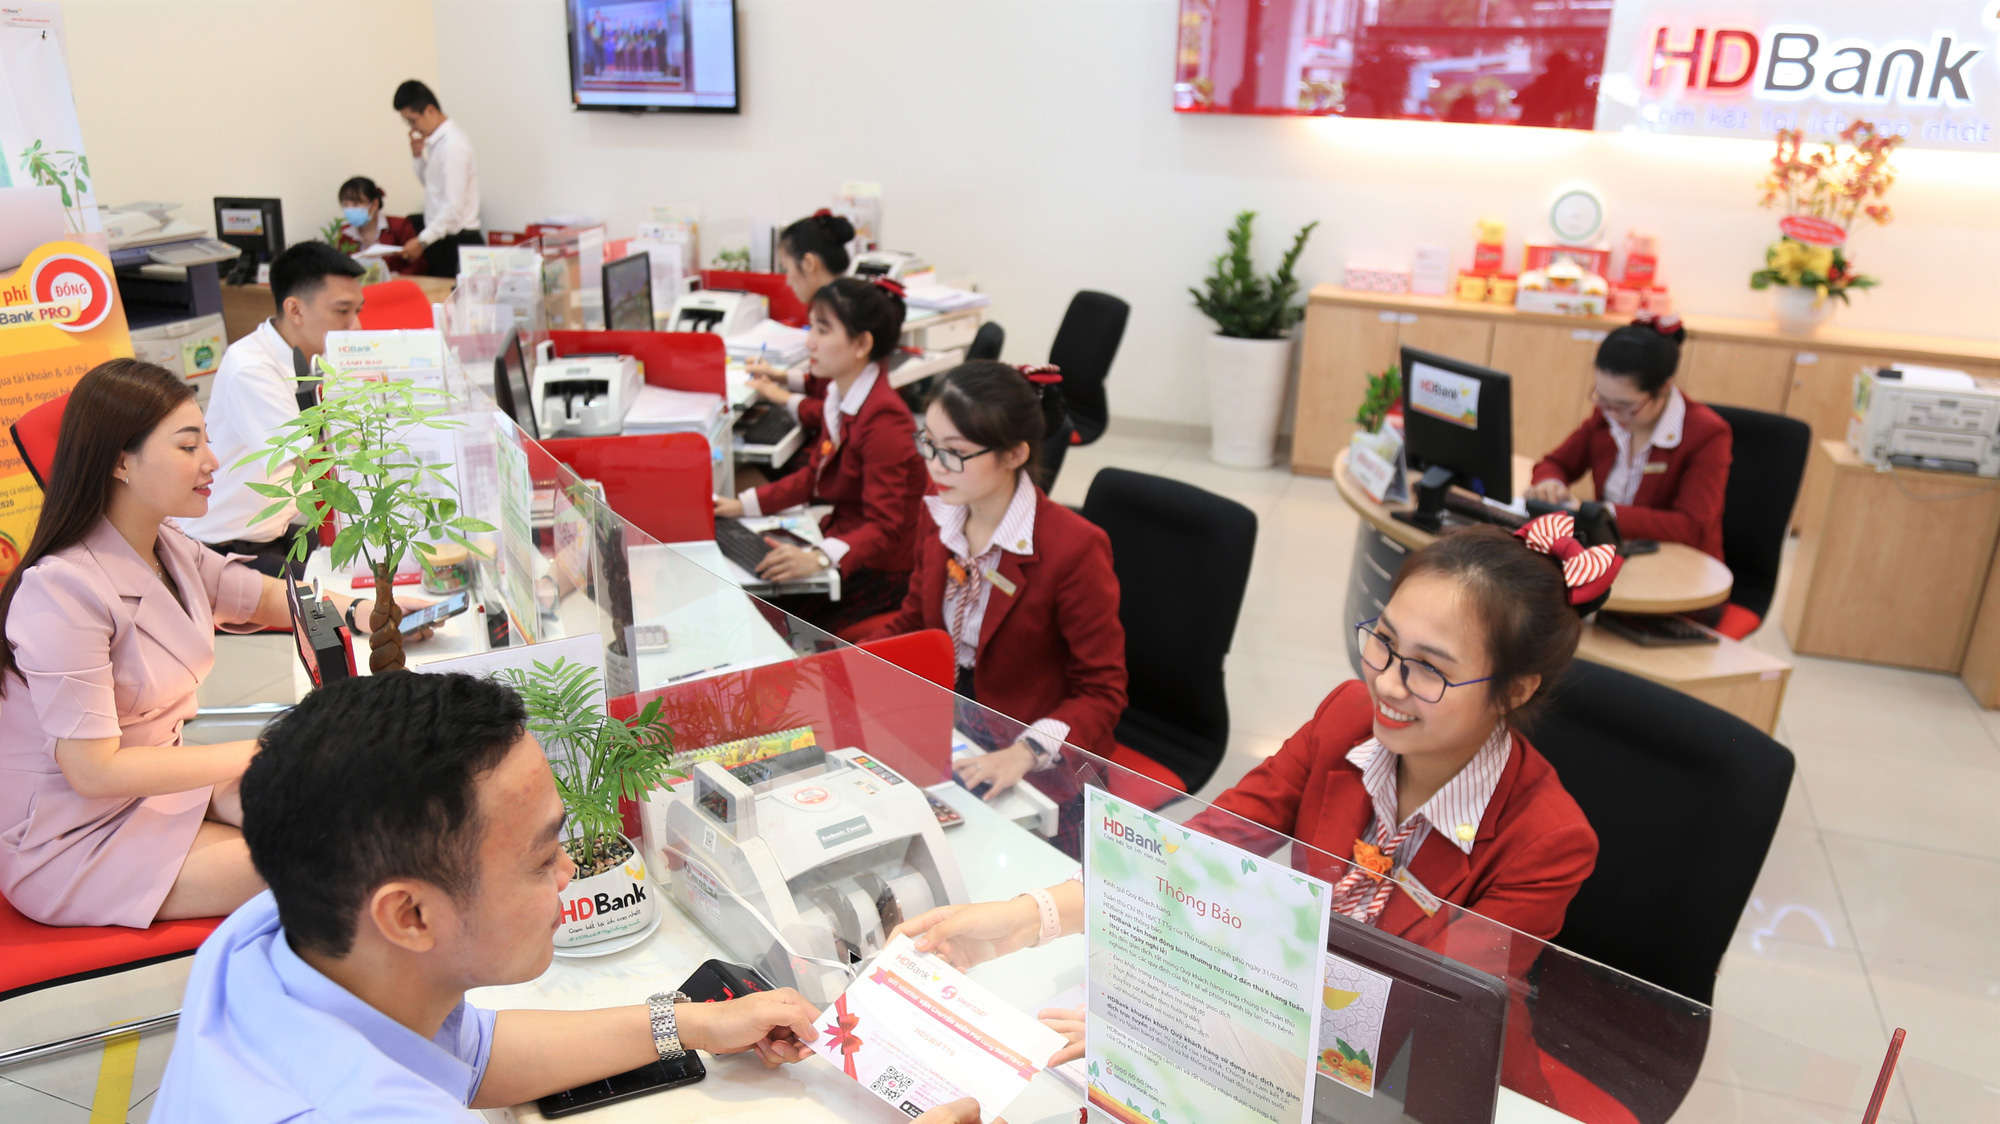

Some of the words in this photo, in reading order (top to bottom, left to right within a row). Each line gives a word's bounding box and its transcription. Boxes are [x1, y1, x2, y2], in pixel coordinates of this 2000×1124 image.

[1648, 27, 1982, 102] HDBank
[2, 285, 28, 306] phí
[55, 282, 88, 298] ĐỒNG
[39, 306, 71, 320] PRO
[26, 370, 54, 382] khoản
[1420, 378, 1460, 400] HDBank
[821, 830, 846, 842] Banknote
[846, 822, 867, 832] Counter
[1103, 816, 1162, 856] HDBank
[560, 882, 647, 924] HDBank
[1155, 874, 1206, 918] Thông
[1211, 901, 1242, 931] Báo
[896, 954, 931, 980] HDBank
[1109, 913, 1131, 928] HDBank
[1132, 924, 1143, 934] vẫn
[1144, 930, 1157, 942] hoạt
[1158, 937, 1174, 950] động
[1175, 946, 1188, 956] bình
[1190, 953, 1212, 968] thường
[1221, 968, 1232, 978] thứ
[1239, 976, 1251, 987] đến
[1252, 982, 1264, 993] thứ
[1270, 992, 1286, 1005] hàng
[1288, 1000, 1304, 1013] tuần
[918, 998, 932, 1009] VẬN
[956, 996, 987, 1018] SWIFT247
[914, 1028, 956, 1056] HDSWIFT19
[1107, 994, 1128, 1010] HDBank
[1130, 1006, 1151, 1024] khuyến
[1153, 1019, 1168, 1032] khích
[1170, 1028, 1182, 1040] Quý
[1184, 1035, 1201, 1050] khách
[1203, 1046, 1218, 1060] hàng
[1221, 1055, 1228, 1064] sử
[1230, 1060, 1245, 1074] dụng
[1247, 1070, 1258, 1080] các
[1260, 1076, 1273, 1088] dịch
[1275, 1085, 1284, 1094] vụ
[1285, 1090, 1300, 1104] giao
[1114, 1063, 1127, 1076] 1900
[1114, 1071, 1166, 1107] www.hdbank.com.vn
